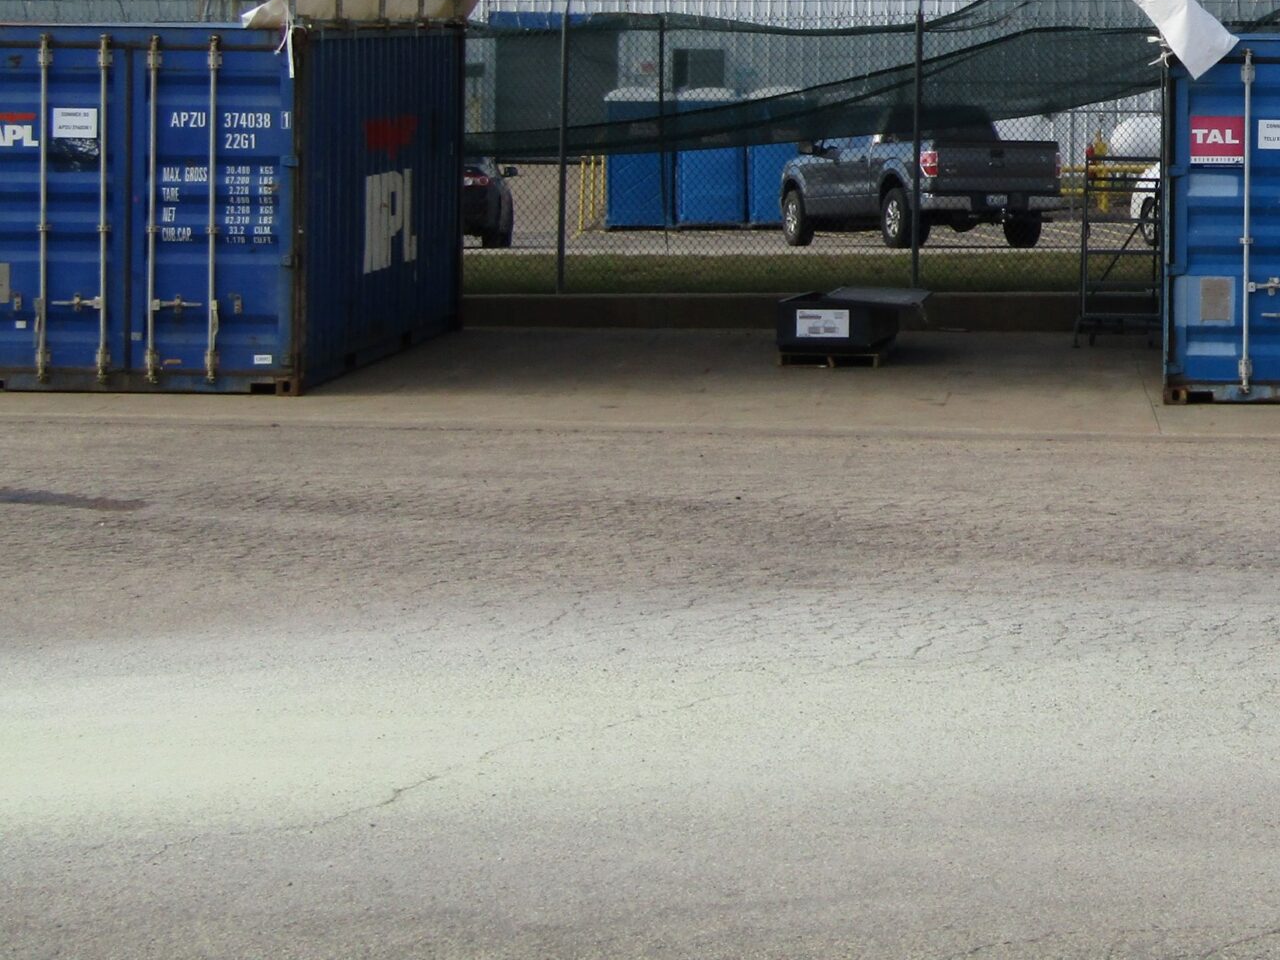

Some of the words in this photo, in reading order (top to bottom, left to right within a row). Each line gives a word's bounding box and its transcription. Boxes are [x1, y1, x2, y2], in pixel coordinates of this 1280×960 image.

[170, 112, 206, 128] APZU
[224, 113, 271, 129] 374038
[282, 112, 290, 129] 1
[0, 125, 39, 147] PL
[225, 133, 256, 149] 22G1
[1191, 128, 1239, 144] TAL
[163, 167, 182, 182] MAX.
[185, 167, 208, 182] GROSS
[260, 166, 273, 175] KGS
[259, 176, 273, 185] LBS
[162, 187, 179, 202] TARE
[163, 207, 176, 223] NET
[260, 206, 273, 215] KGS
[259, 216, 273, 225] LBS
[228, 226, 245, 235] 33.2
